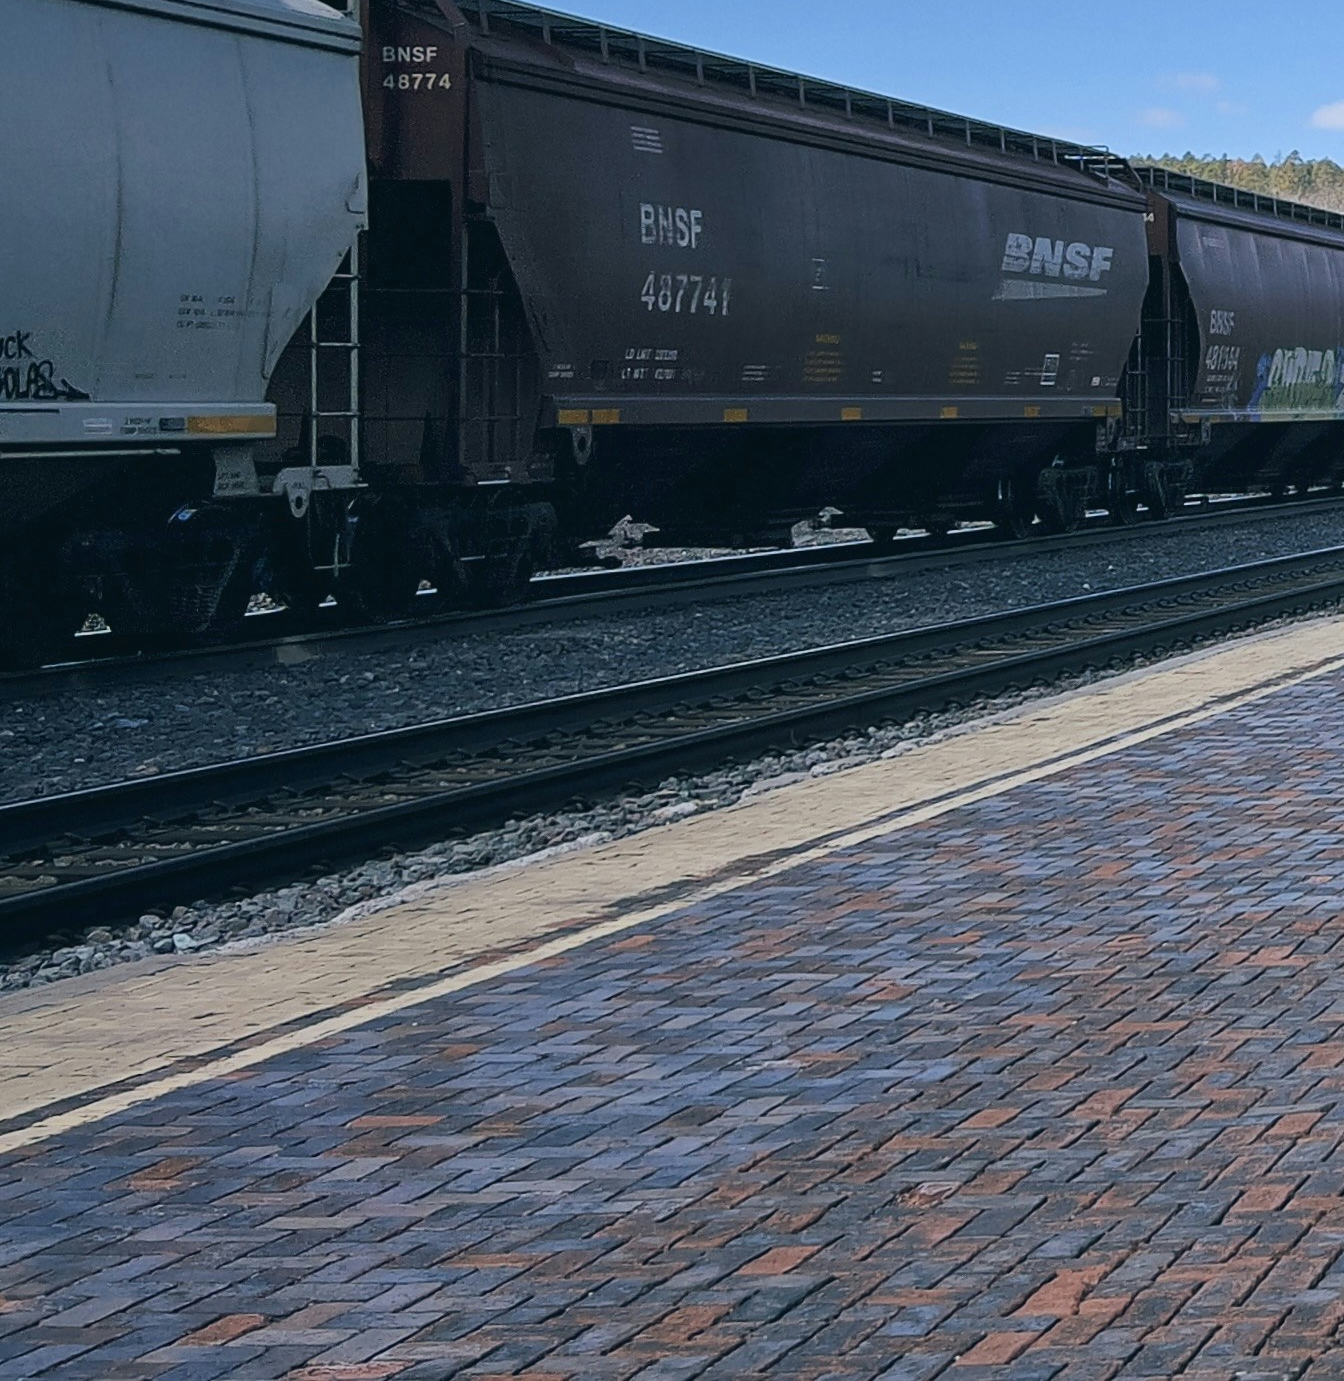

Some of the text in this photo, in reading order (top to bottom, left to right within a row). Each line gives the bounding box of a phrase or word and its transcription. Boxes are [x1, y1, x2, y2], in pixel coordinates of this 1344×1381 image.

[382, 46, 438, 63] BNSF
[382, 73, 452, 90] 48774
[639, 202, 702, 249] BNSF
[1001, 232, 1114, 282] BNSF
[1209, 309, 1235, 336] BNSF
